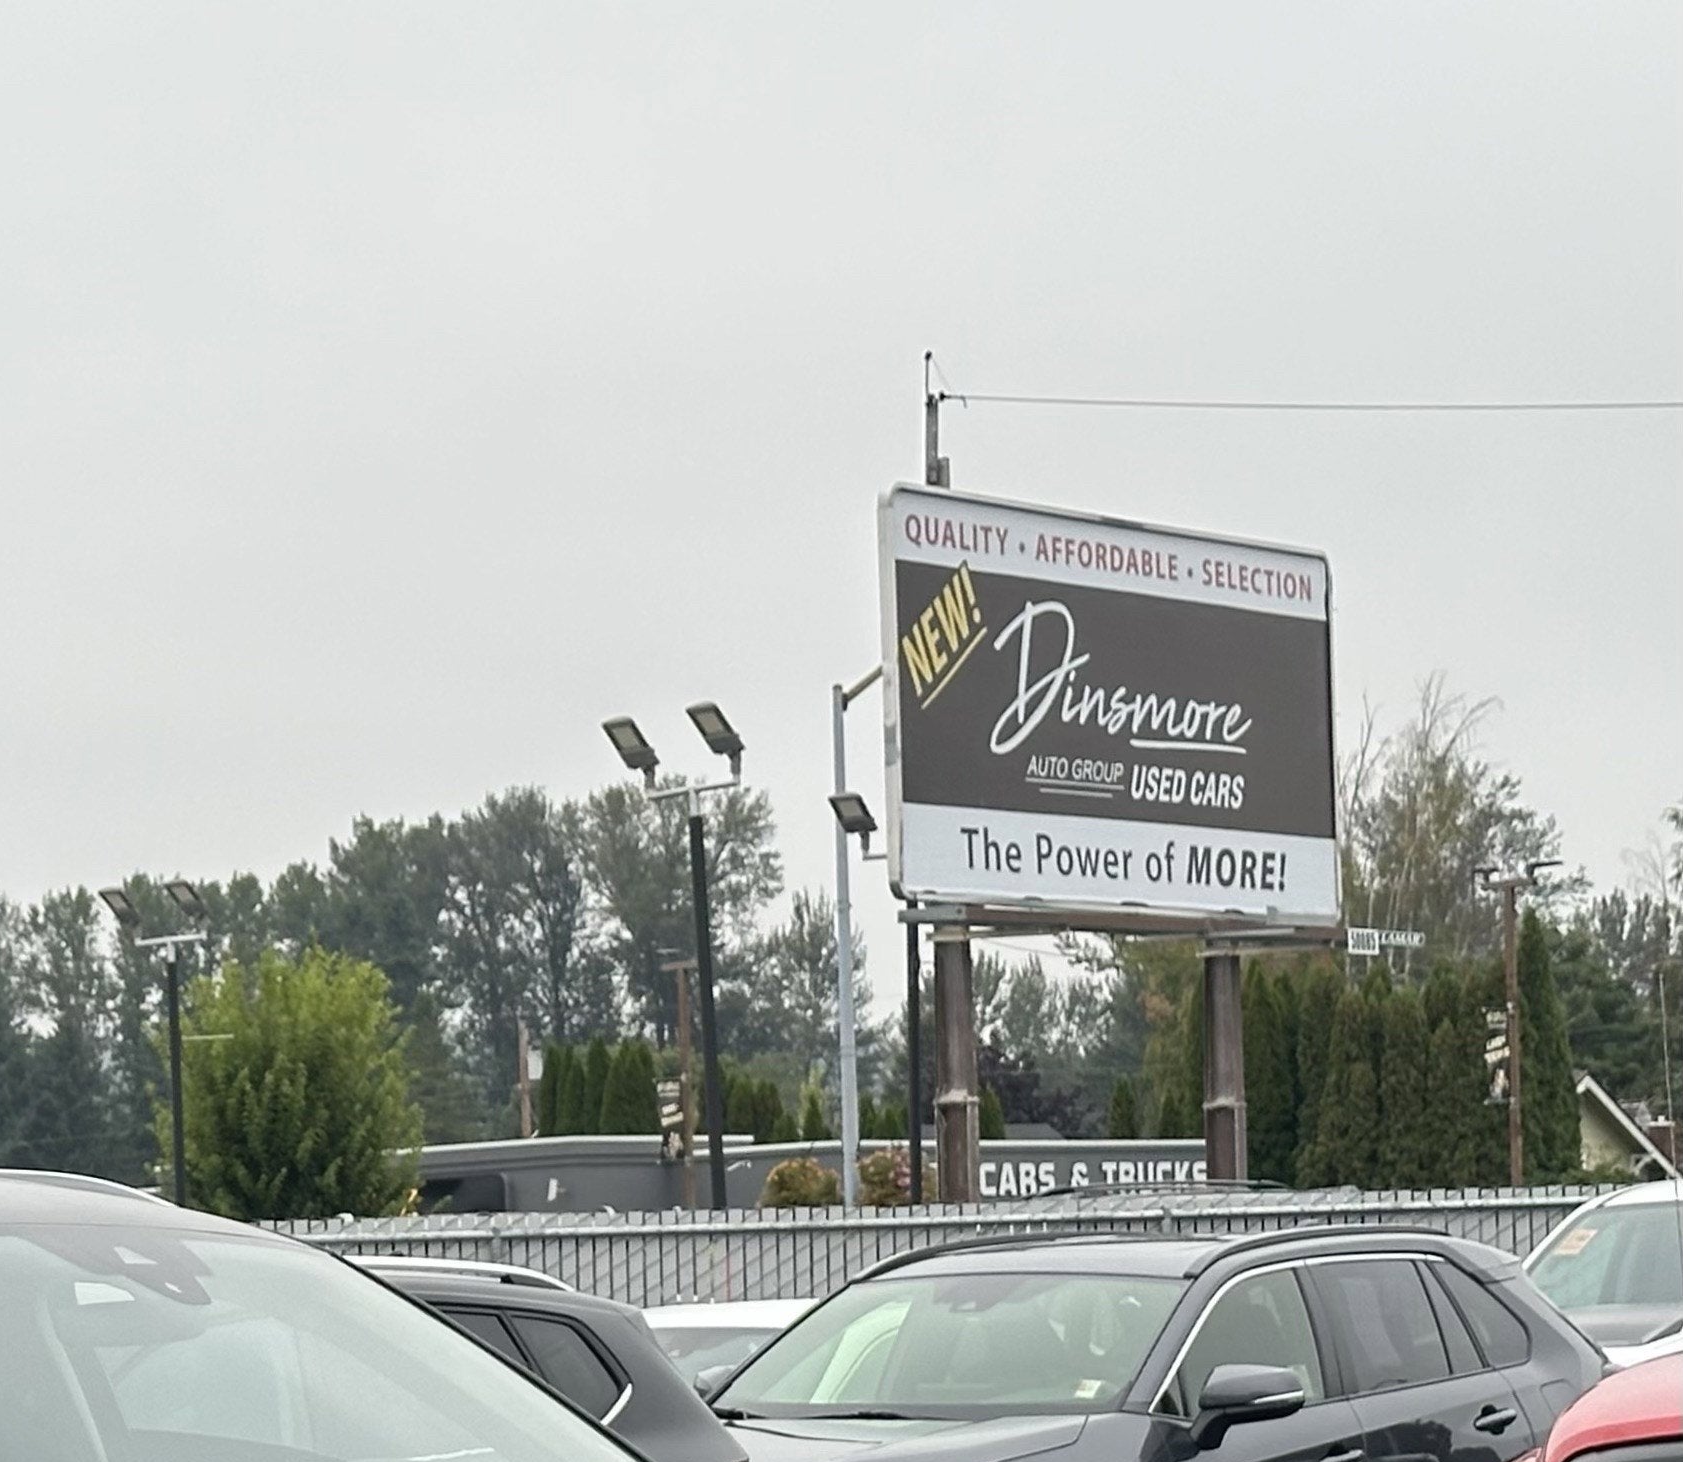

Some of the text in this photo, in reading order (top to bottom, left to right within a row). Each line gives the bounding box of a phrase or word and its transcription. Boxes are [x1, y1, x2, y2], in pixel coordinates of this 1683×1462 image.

[905, 514, 1312, 602] QUALITY AFFORDABLE SELECTION
[902, 563, 981, 697] NEW!
[990, 600, 1252, 755] Dinsmore
[1027, 754, 1245, 809] AUTO GROUP USED CARS
[960, 826, 1287, 892] The Power of MORE!
[979, 1161, 1055, 1197] CARS
